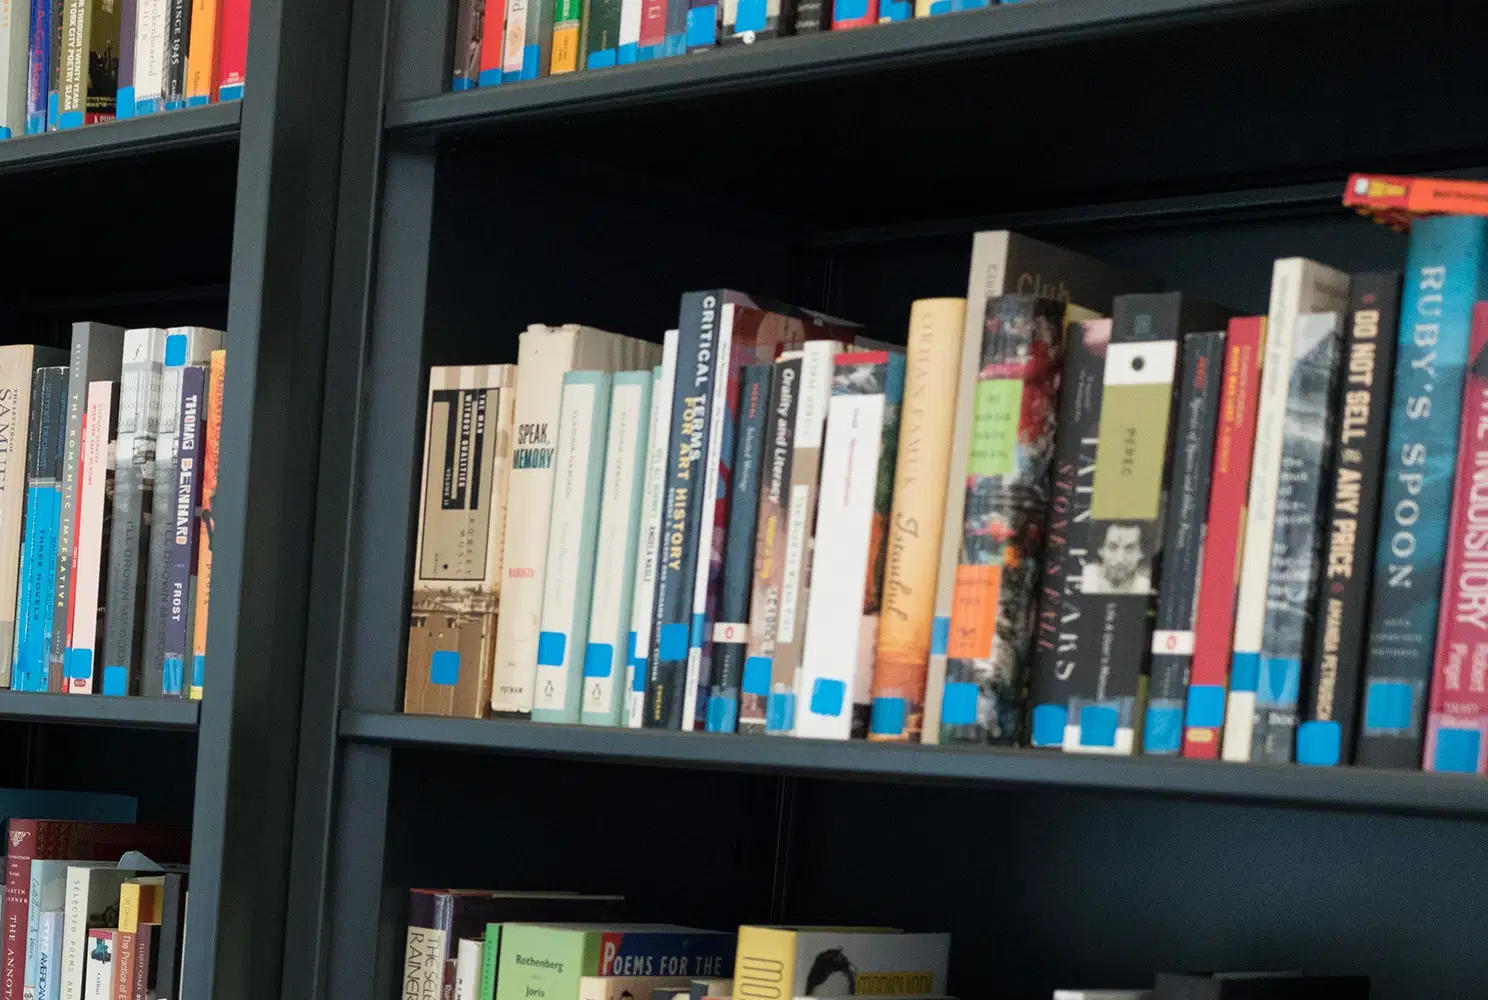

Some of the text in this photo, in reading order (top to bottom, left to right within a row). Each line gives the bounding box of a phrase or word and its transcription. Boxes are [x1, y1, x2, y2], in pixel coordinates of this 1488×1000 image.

[72, 8, 84, 110] THROUGH TWENTY YEARS
[690, 296, 716, 461] CRITICAL TERMS
[512, 448, 554, 469] MEMORY
[517, 422, 551, 445] SPEAK,
[768, 368, 796, 505] Orality and Literacy
[1121, 427, 1138, 476] PEREC
[1388, 266, 1446, 588] RUBY'S SPOON
[172, 394, 198, 622] THOMAS BERNHARD FROST
[668, 397, 696, 570] FOR ART HISTORY
[33, 528, 46, 622] THREE NOVELS
[886, 511, 919, 620] Istanbul
[6, 914, 16, 942] THE
[425, 937, 438, 967] THE
[602, 942, 722, 977] POEMS FOR THE
[515, 954, 564, 974] Rothenberg
[525, 985, 545, 998] Joris
